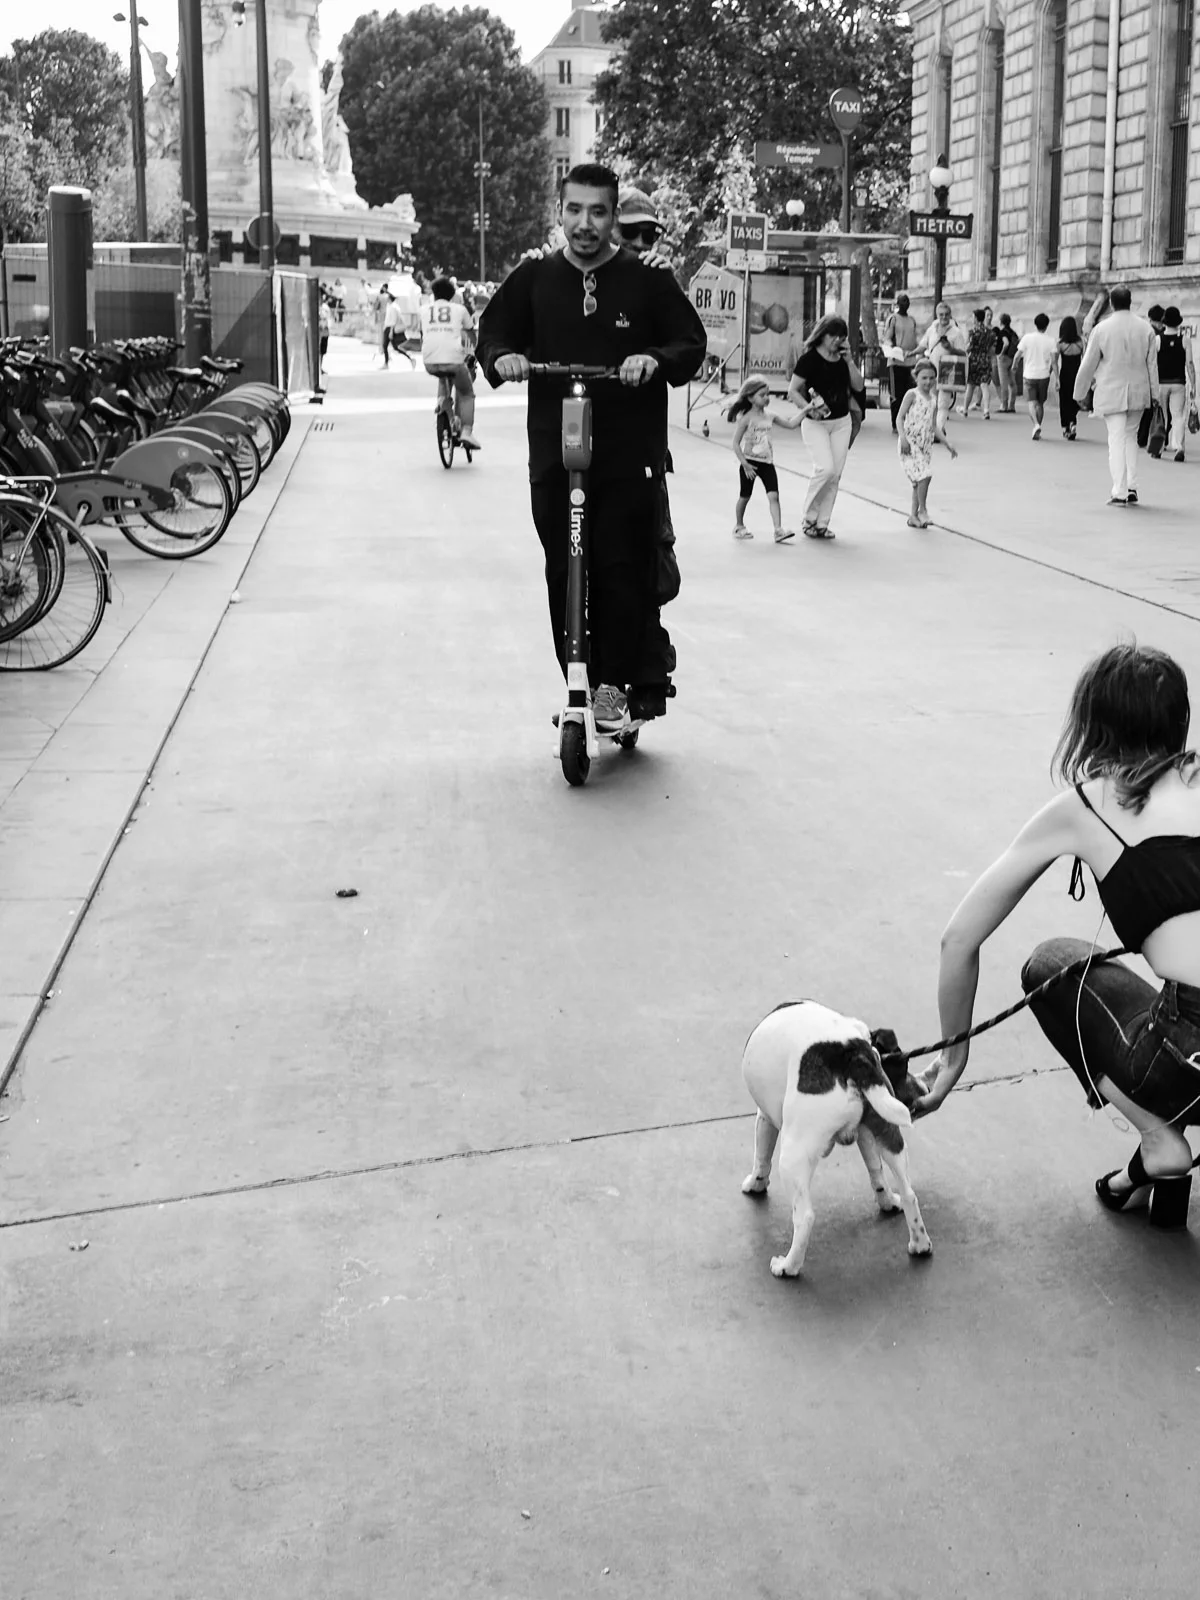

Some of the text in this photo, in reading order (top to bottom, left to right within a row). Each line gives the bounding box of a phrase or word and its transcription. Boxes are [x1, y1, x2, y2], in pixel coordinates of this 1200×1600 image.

[833, 100, 860, 113] TAXI
[776, 144, 821, 156] République
[784, 154, 814, 165] Temple
[732, 225, 763, 241] TAXIS
[916, 217, 966, 235] METRO
[428, 305, 452, 325] 18
